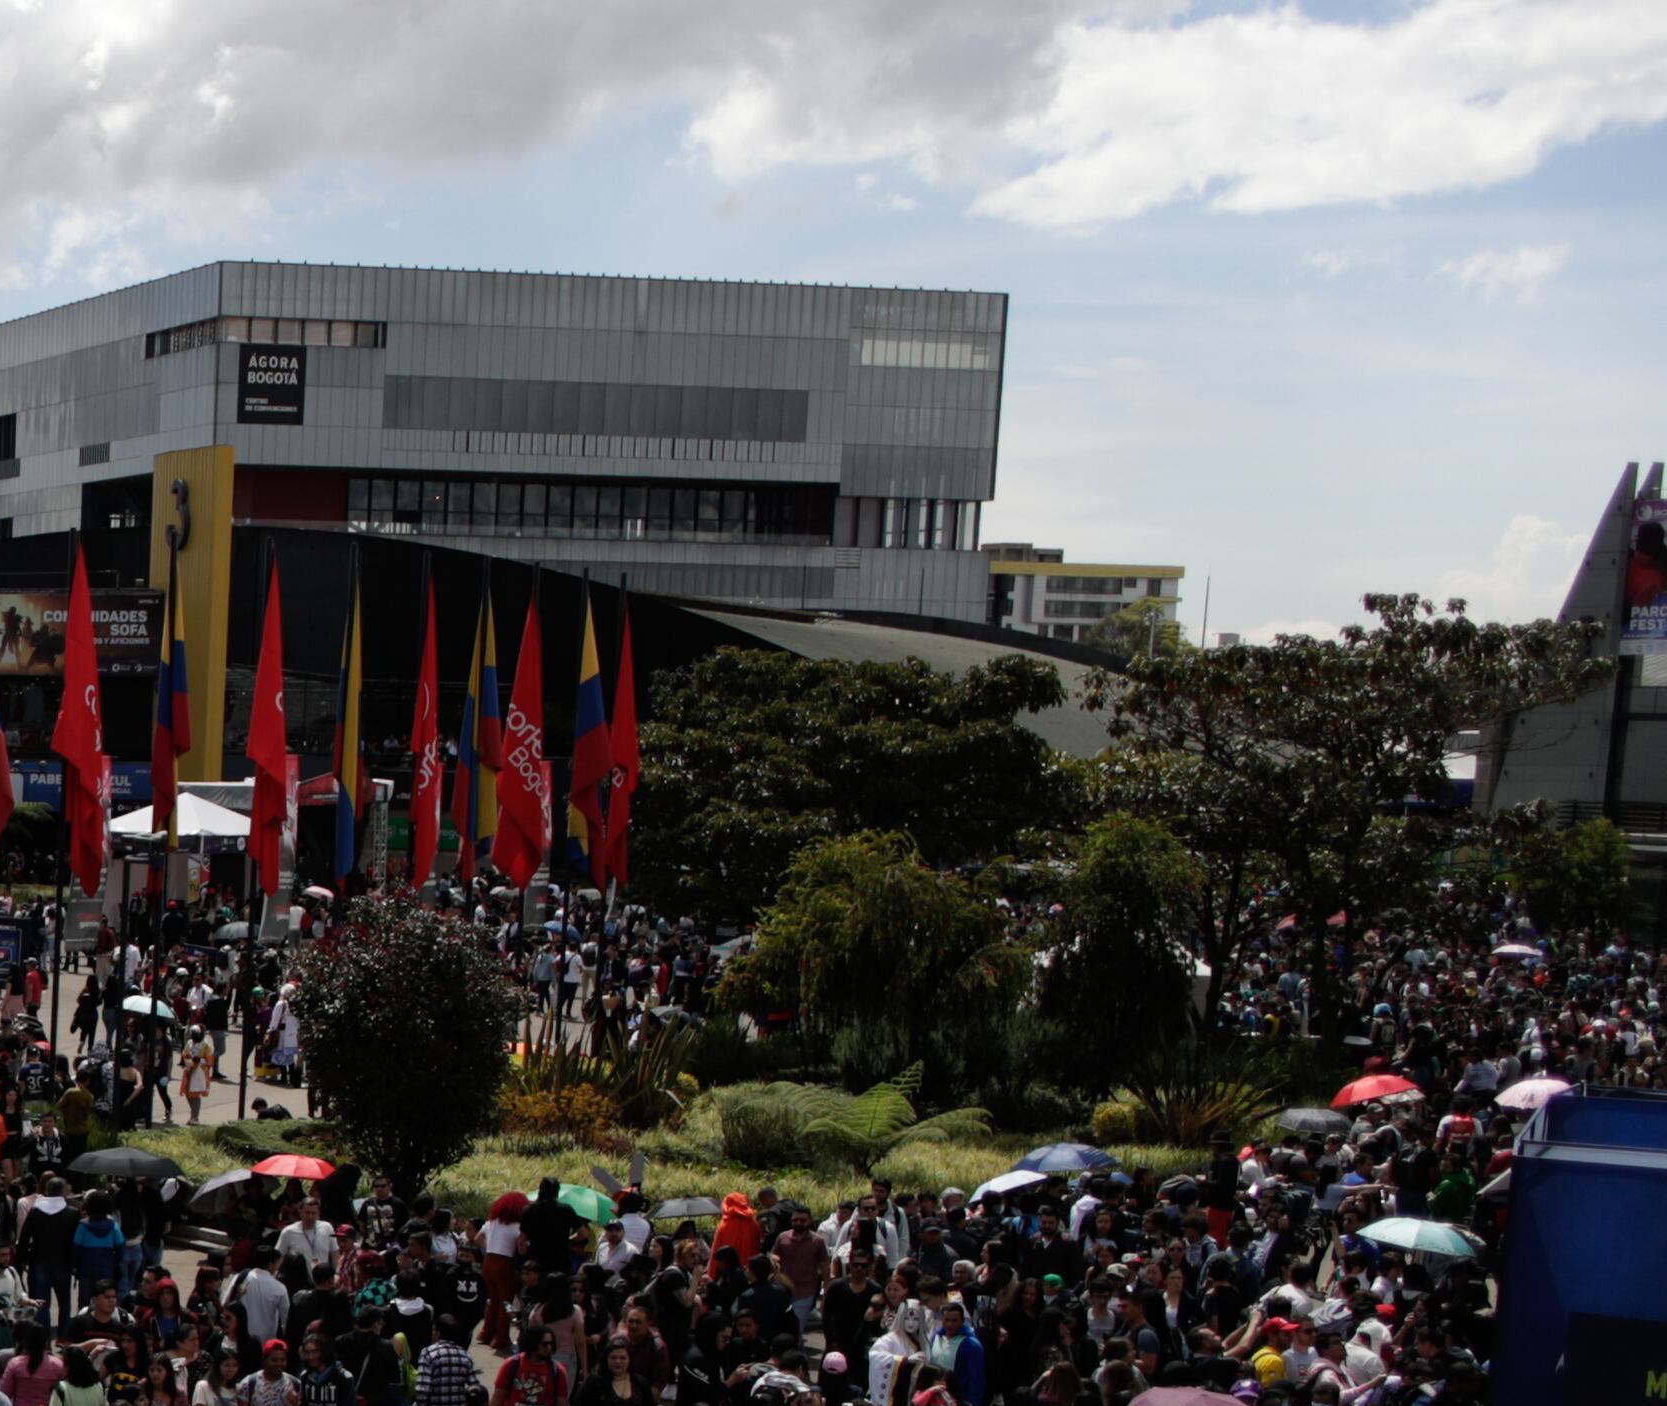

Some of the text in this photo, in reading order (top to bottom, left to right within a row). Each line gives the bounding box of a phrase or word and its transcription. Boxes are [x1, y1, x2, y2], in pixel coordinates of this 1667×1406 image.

[248, 352, 299, 370] ÁGORA
[247, 369, 298, 385] BOGOTÁ
[42, 610, 148, 623] COIDADES
[110, 623, 148, 637] SOFA
